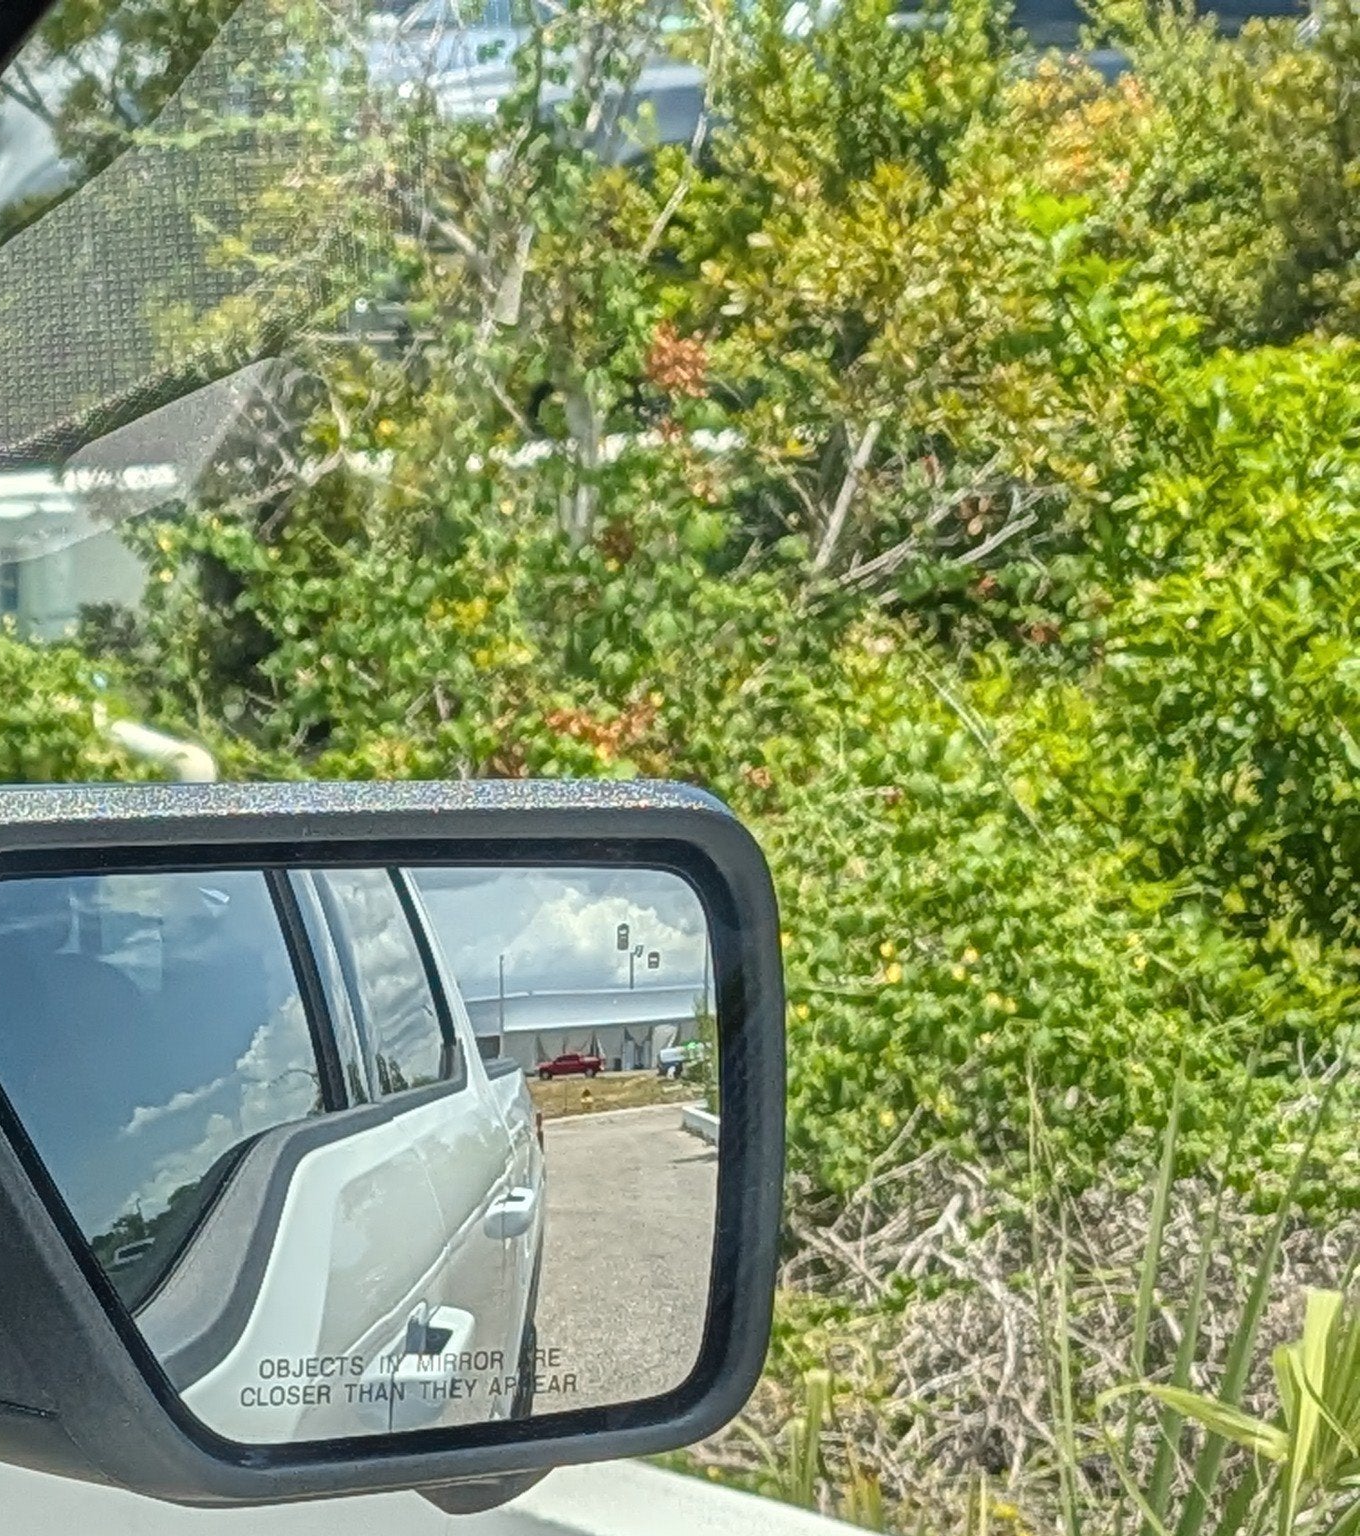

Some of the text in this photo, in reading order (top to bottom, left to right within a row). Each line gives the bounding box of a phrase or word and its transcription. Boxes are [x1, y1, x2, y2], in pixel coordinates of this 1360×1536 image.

[259, 1348, 561, 1379] OBJECTS IN MIRROR RE
[240, 1373, 577, 1407] CLOSER THAN THEY APEAR
